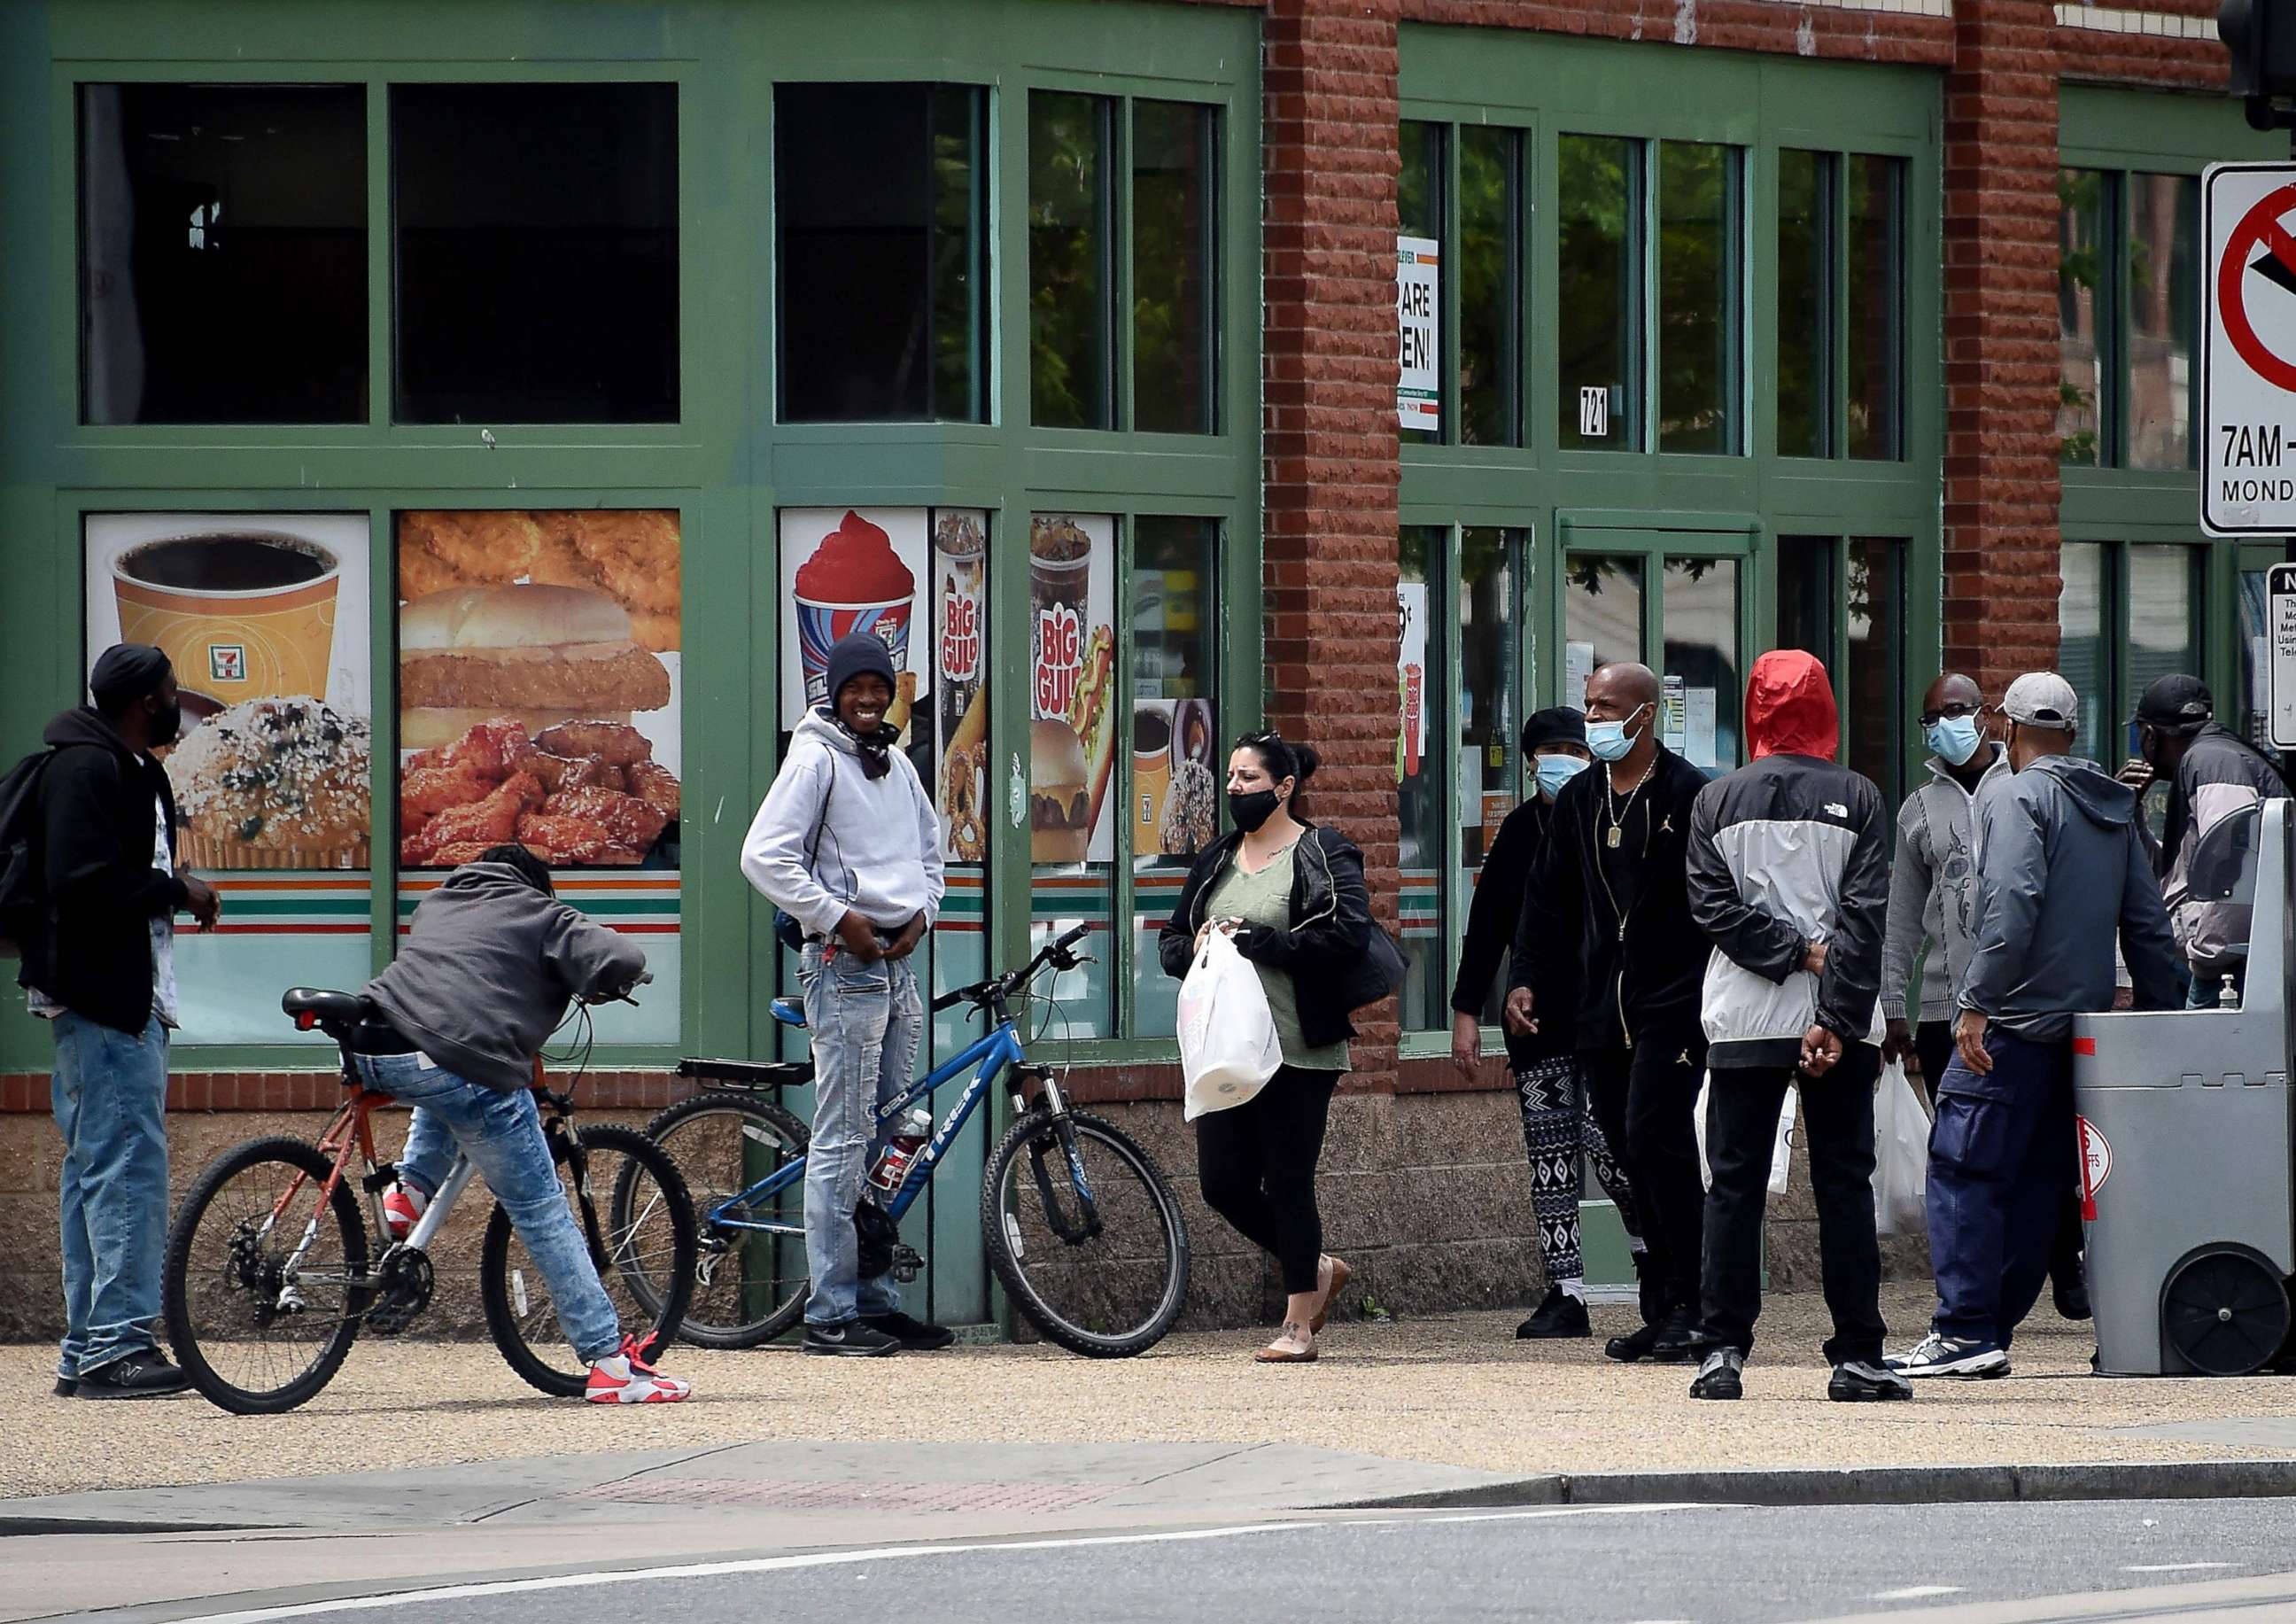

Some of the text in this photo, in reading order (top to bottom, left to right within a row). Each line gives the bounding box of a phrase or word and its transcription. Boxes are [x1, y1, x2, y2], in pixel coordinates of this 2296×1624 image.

[1401, 281, 1430, 317] ARE
[1582, 389, 1605, 433] 721
[2222, 479, 2296, 501] MOND
[942, 635, 977, 674] GULP
[880, 1091, 910, 1118] 820
